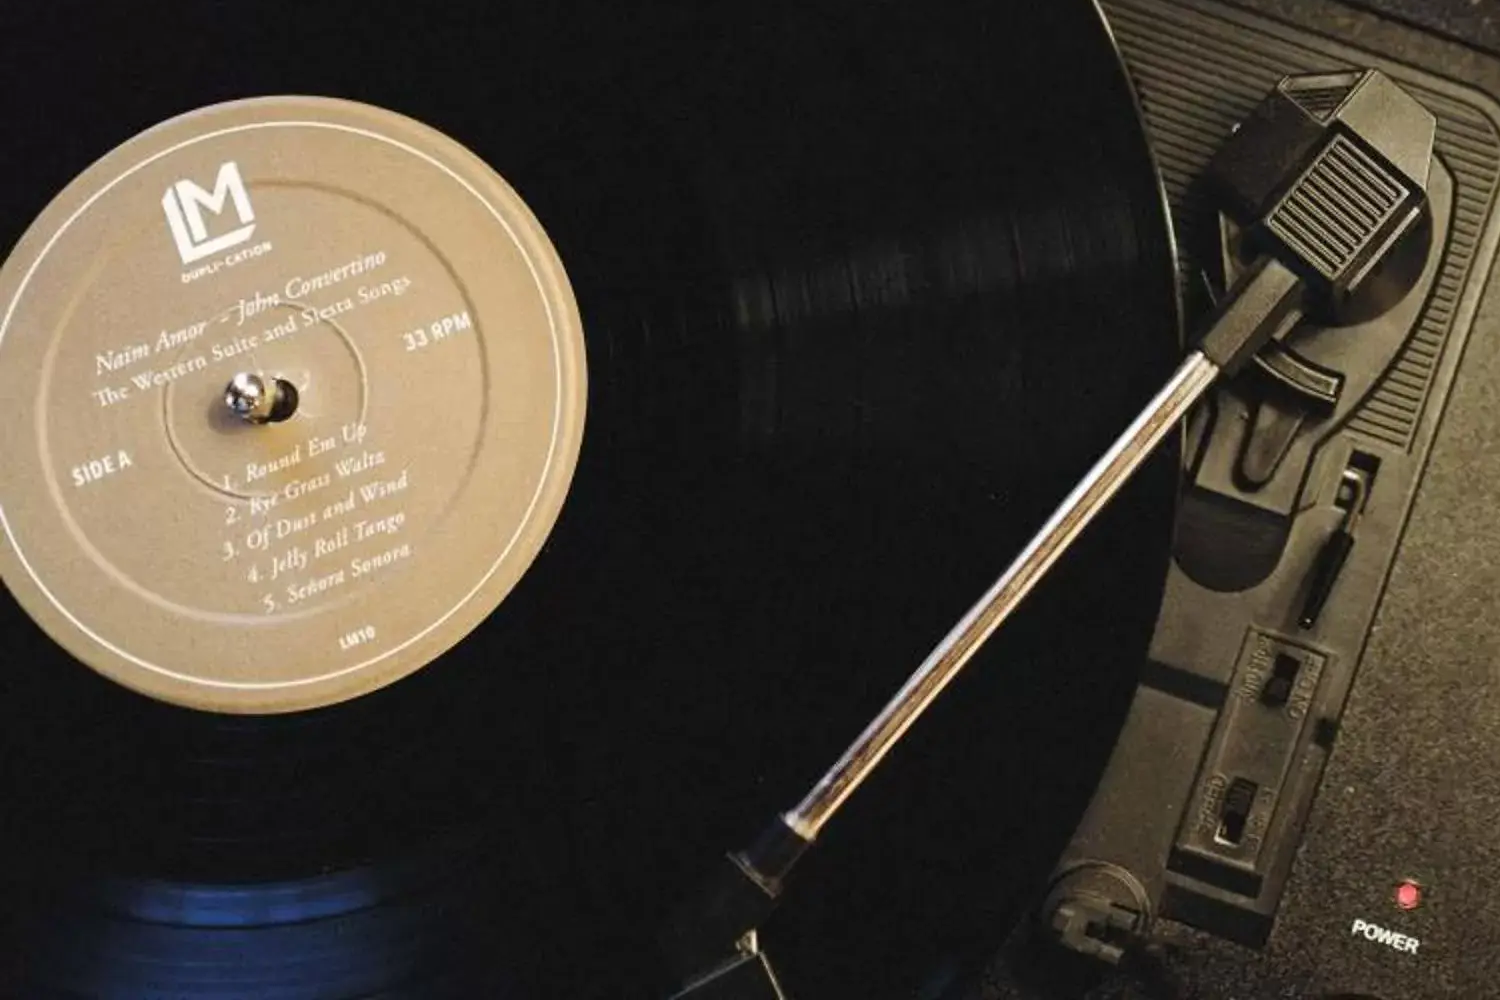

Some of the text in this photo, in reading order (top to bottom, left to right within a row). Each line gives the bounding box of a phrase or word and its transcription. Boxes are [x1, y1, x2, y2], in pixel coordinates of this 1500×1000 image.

[155, 320, 208, 352] Amor
[237, 292, 279, 326] John
[284, 250, 387, 300] Convertino
[402, 311, 471, 352] 33 RPM
[90, 274, 412, 407] The Western Suite and Siesta Songs
[71, 449, 132, 487] SIDE A
[245, 444, 301, 483] Round
[308, 435, 336, 458] Em
[341, 422, 368, 446] Up
[250, 494, 279, 519] Rye
[284, 471, 331, 499] Grass
[335, 450, 386, 478] Waltz
[246, 523, 271, 551] Of
[276, 511, 318, 540] Dust
[322, 490, 356, 520] and
[359, 470, 409, 503] Wind
[271, 546, 308, 581] Jelly
[314, 526, 349, 559] Roll
[353, 510, 406, 542] Tango
[350, 541, 411, 578] Sonora
[1351, 918, 1421, 955] POWER
